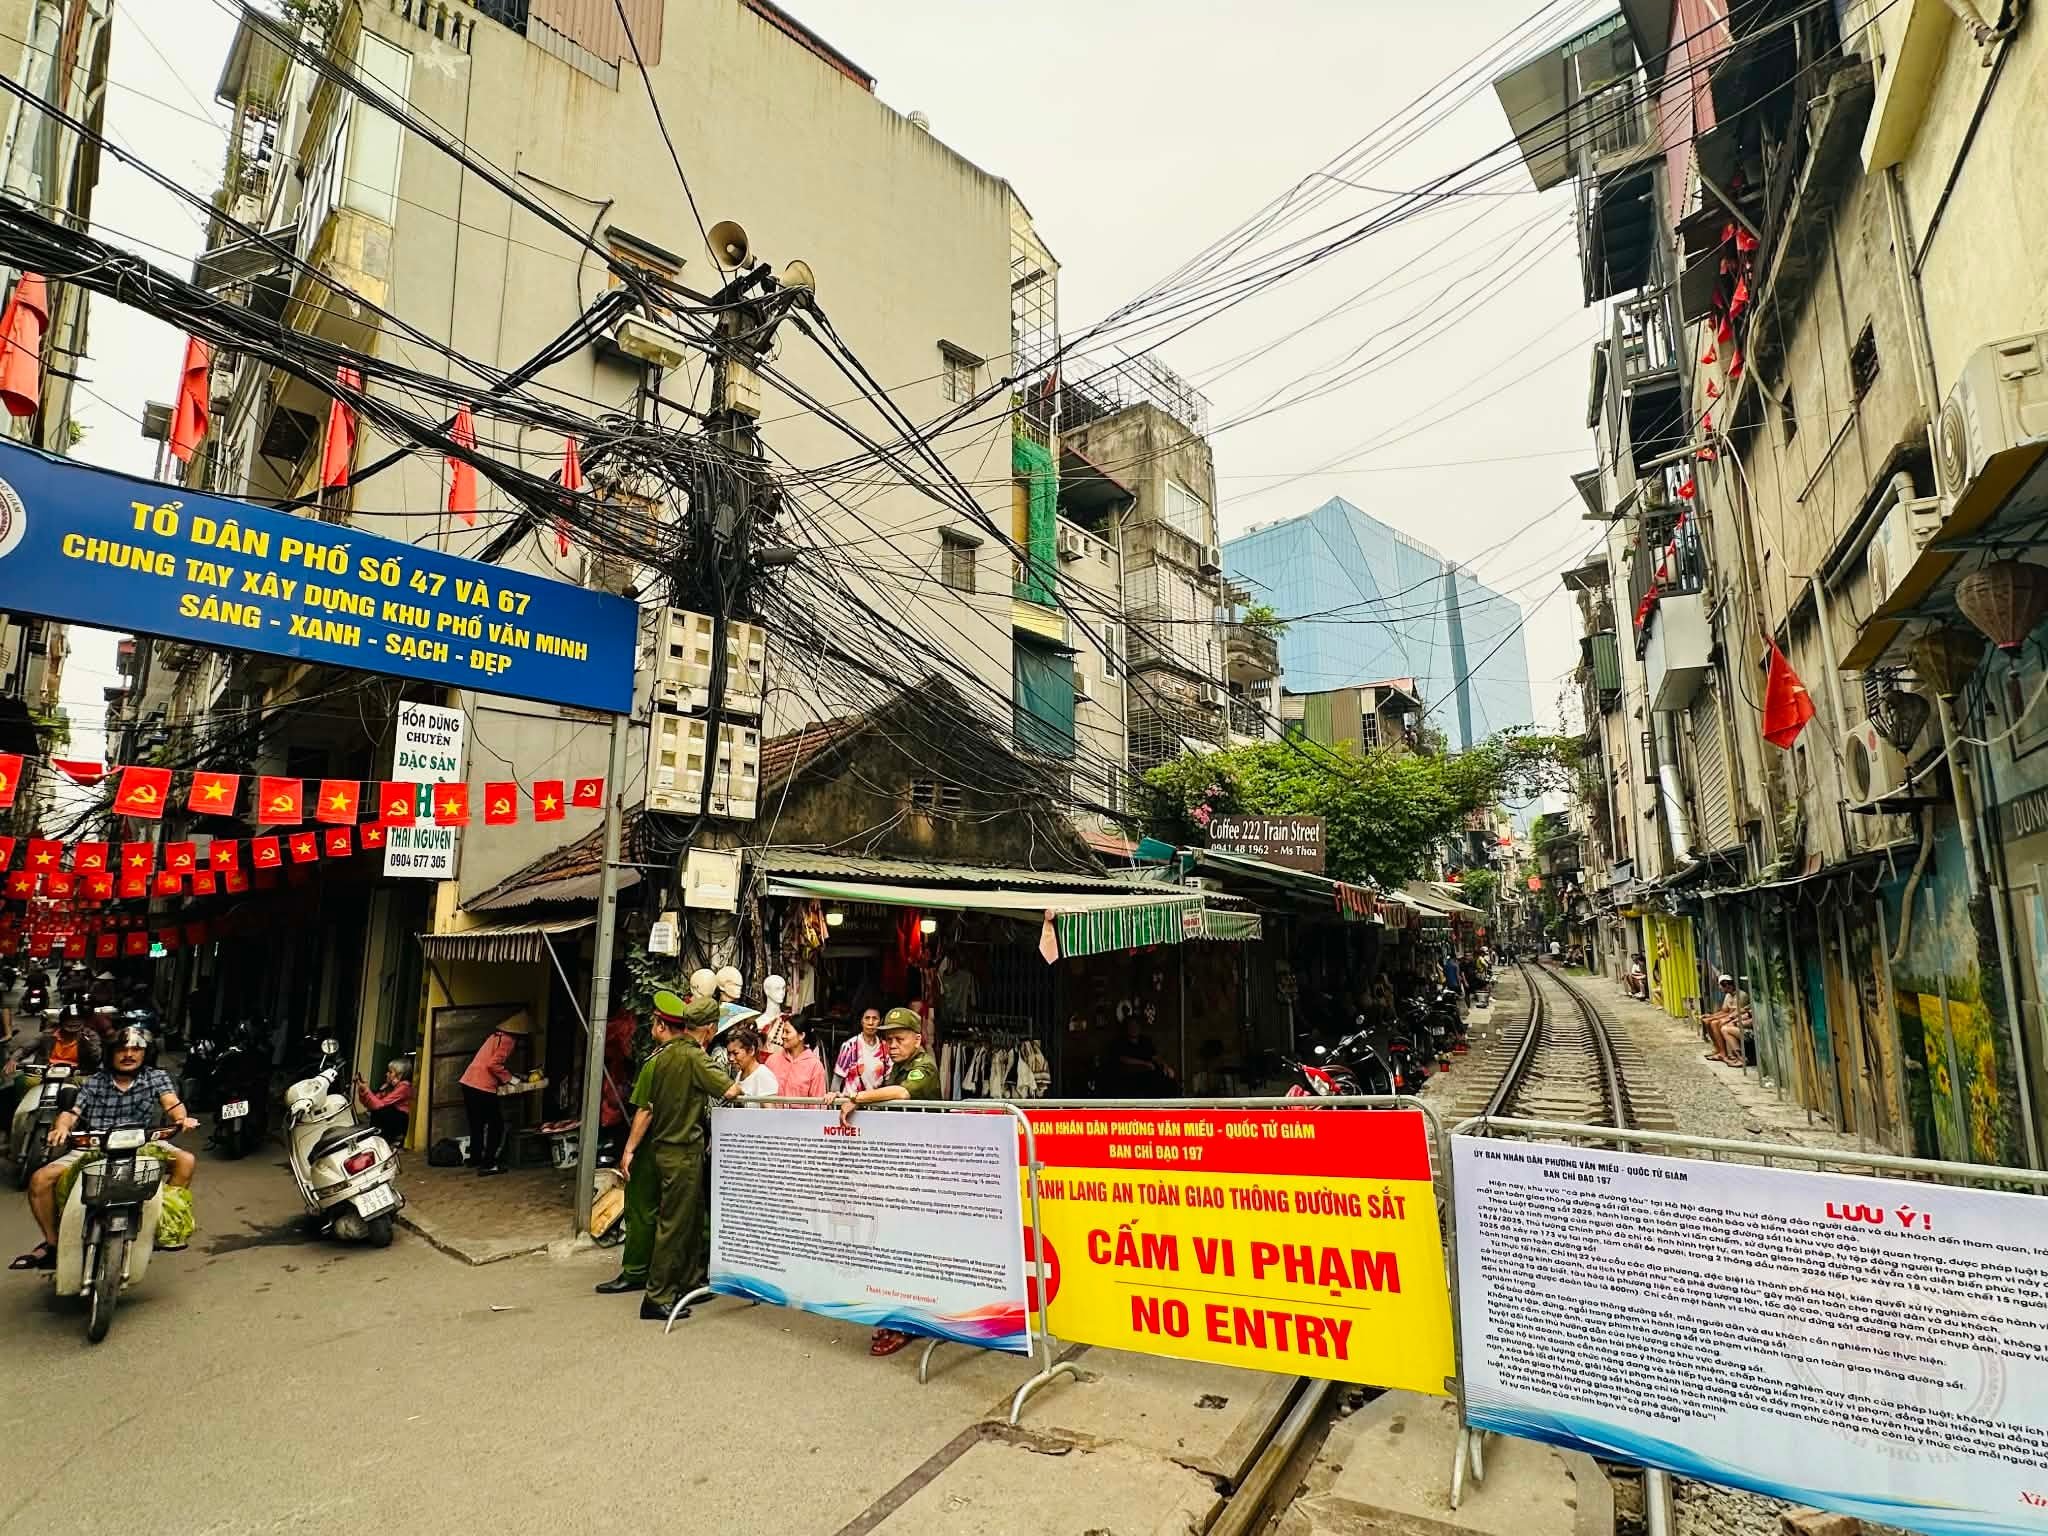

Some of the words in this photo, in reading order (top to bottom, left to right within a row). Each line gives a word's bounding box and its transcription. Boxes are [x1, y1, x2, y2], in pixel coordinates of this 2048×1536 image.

[131, 501, 184, 536] TỔ
[190, 518, 270, 558] DÂN
[280, 537, 351, 575] PHỐ
[358, 556, 403, 587] SỐ
[409, 570, 446, 596] 47
[455, 578, 490, 608] VÀ
[498, 590, 531, 616] 67
[62, 533, 176, 578] CHUNG
[185, 558, 234, 588] TAY
[240, 571, 298, 601] XÂY
[304, 584, 375, 618] DỰNG
[382, 600, 430, 629] KHU
[436, 612, 483, 639] PHỐ
[488, 622, 530, 650] VĂN
[536, 635, 588, 662] MINH
[179, 594, 262, 629] SÁNG
[288, 614, 361, 648] XANH
[384, 633, 449, 662] SẠCH
[470, 648, 513, 676] ĐẸP
[402, 709, 426, 728] HÒA
[428, 713, 460, 732] DŨNG
[406, 731, 451, 746] CHUYÊN
[399, 750, 427, 770] ĐẶC
[430, 752, 456, 771] SẢN
[1210, 818, 1240, 840] Coffee
[1242, 820, 1260, 840] 222
[1262, 820, 1288, 841] Train
[1290, 820, 1320, 842] Street
[390, 854, 411, 867] 0904
[414, 854, 430, 868] 677
[430, 855, 446, 868] 305
[1234, 844, 1246, 854] 48
[1248, 844, 1269, 854] 1962
[1280, 845, 1293, 856] Ms
[1296, 845, 1317, 856] Thoa
[1032, 1122, 1053, 1134] BAN
[1055, 1122, 1084, 1135] NHÂN
[1086, 1121, 1108, 1136] DÂN
[1111, 1120, 1154, 1136] PHƯỜNG
[1158, 1121, 1181, 1137] VĂN
[1184, 1119, 1214, 1138] MIẾU
[1225, 1118, 1259, 1138] QUỐC
[1262, 1118, 1278, 1138] TỬ
[1281, 1120, 1316, 1139] GIÁM
[1109, 1144, 1132, 1159] BAN
[1134, 1142, 1153, 1159] CHỈ
[1156, 1146, 1178, 1163] ĐẠO
[1182, 1146, 1203, 1160] 197
[1485, 1151, 1501, 1160] BAN
[1502, 1152, 1525, 1163] NHÂN
[1526, 1154, 1543, 1165] DÂN
[1544, 1156, 1578, 1169] PHƯỜNG
[1579, 1159, 1596, 1170] VĂN
[1598, 1160, 1620, 1174] MIẾU
[1627, 1164, 1650, 1177] QUỐC
[1652, 1166, 1663, 1178] TỬ
[1664, 1168, 1688, 1182] GIÁM
[1544, 1169, 1560, 1180] BAN
[1562, 1170, 1576, 1181] CHỈ
[1578, 1172, 1594, 1184] ĐẠO
[1596, 1174, 1612, 1185] 197
[1069, 1181, 1107, 1202] LANG
[1112, 1182, 1134, 1204] AN
[1137, 1179, 1180, 1207] TOÀN
[1185, 1185, 1224, 1209] GIAO
[1228, 1184, 1290, 1214] THÔNG
[1294, 1187, 1362, 1218] ĐƯỜNG
[1367, 1186, 1406, 1220] SẮT
[1825, 1200, 1884, 1224] LƯU
[1697, 1206, 1723, 1216] đang
[1900, 1231, 1935, 1241] khách
[1962, 1239, 1992, 1248] tham
[1995, 1243, 2030, 1254] quan,
[1087, 1218, 1180, 1271] CẤM
[1192, 1236, 1235, 1277] VI
[1250, 1240, 1401, 1296] PHẠM
[1859, 1246, 1880, 1256] biệt
[1882, 1250, 1910, 1260] quan
[1980, 1261, 2011, 1273] pháp
[1801, 1266, 1826, 1276] 2026
[1828, 1269, 1848, 1280] tiếp
[1851, 1274, 1868, 1284] tục
[1907, 1282, 1920, 1290] 18
[1942, 1287, 1964, 1296] làm
[1967, 1289, 1992, 1300] chết
[1996, 1295, 2009, 1303] 15
[1874, 1297, 1905, 1310] quyết
[2006, 1317, 2036, 1329] hành
[1927, 1315, 1941, 1324] và
[1944, 1318, 1958, 1326] du
[1131, 1295, 1190, 1338] NO
[1204, 1303, 1354, 1360] ENTRY
[1927, 1326, 1974, 1341] (phanh)
[2003, 1338, 2041, 1352] không
[1939, 1338, 1969, 1351] chụp
[2000, 1349, 2030, 1361] quay
